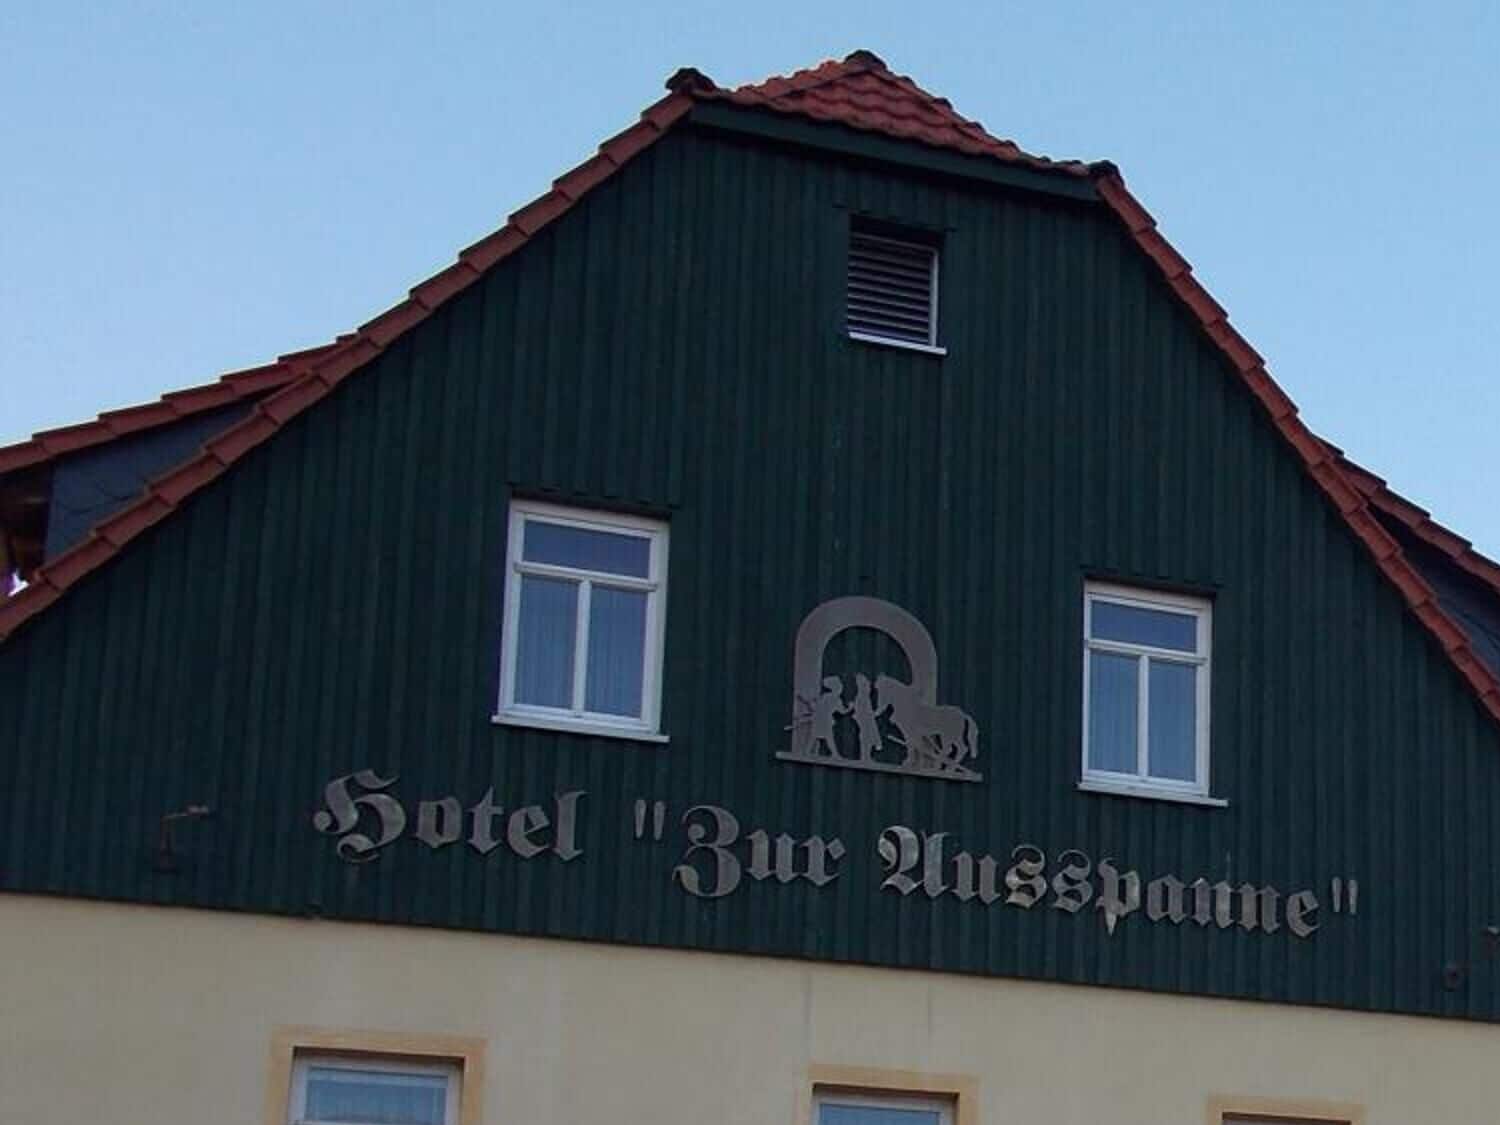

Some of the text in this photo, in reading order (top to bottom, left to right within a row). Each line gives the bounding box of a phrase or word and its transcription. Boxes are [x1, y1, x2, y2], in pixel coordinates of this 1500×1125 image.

[314, 769, 1359, 939] Hotel "Zur Ausspanne"
